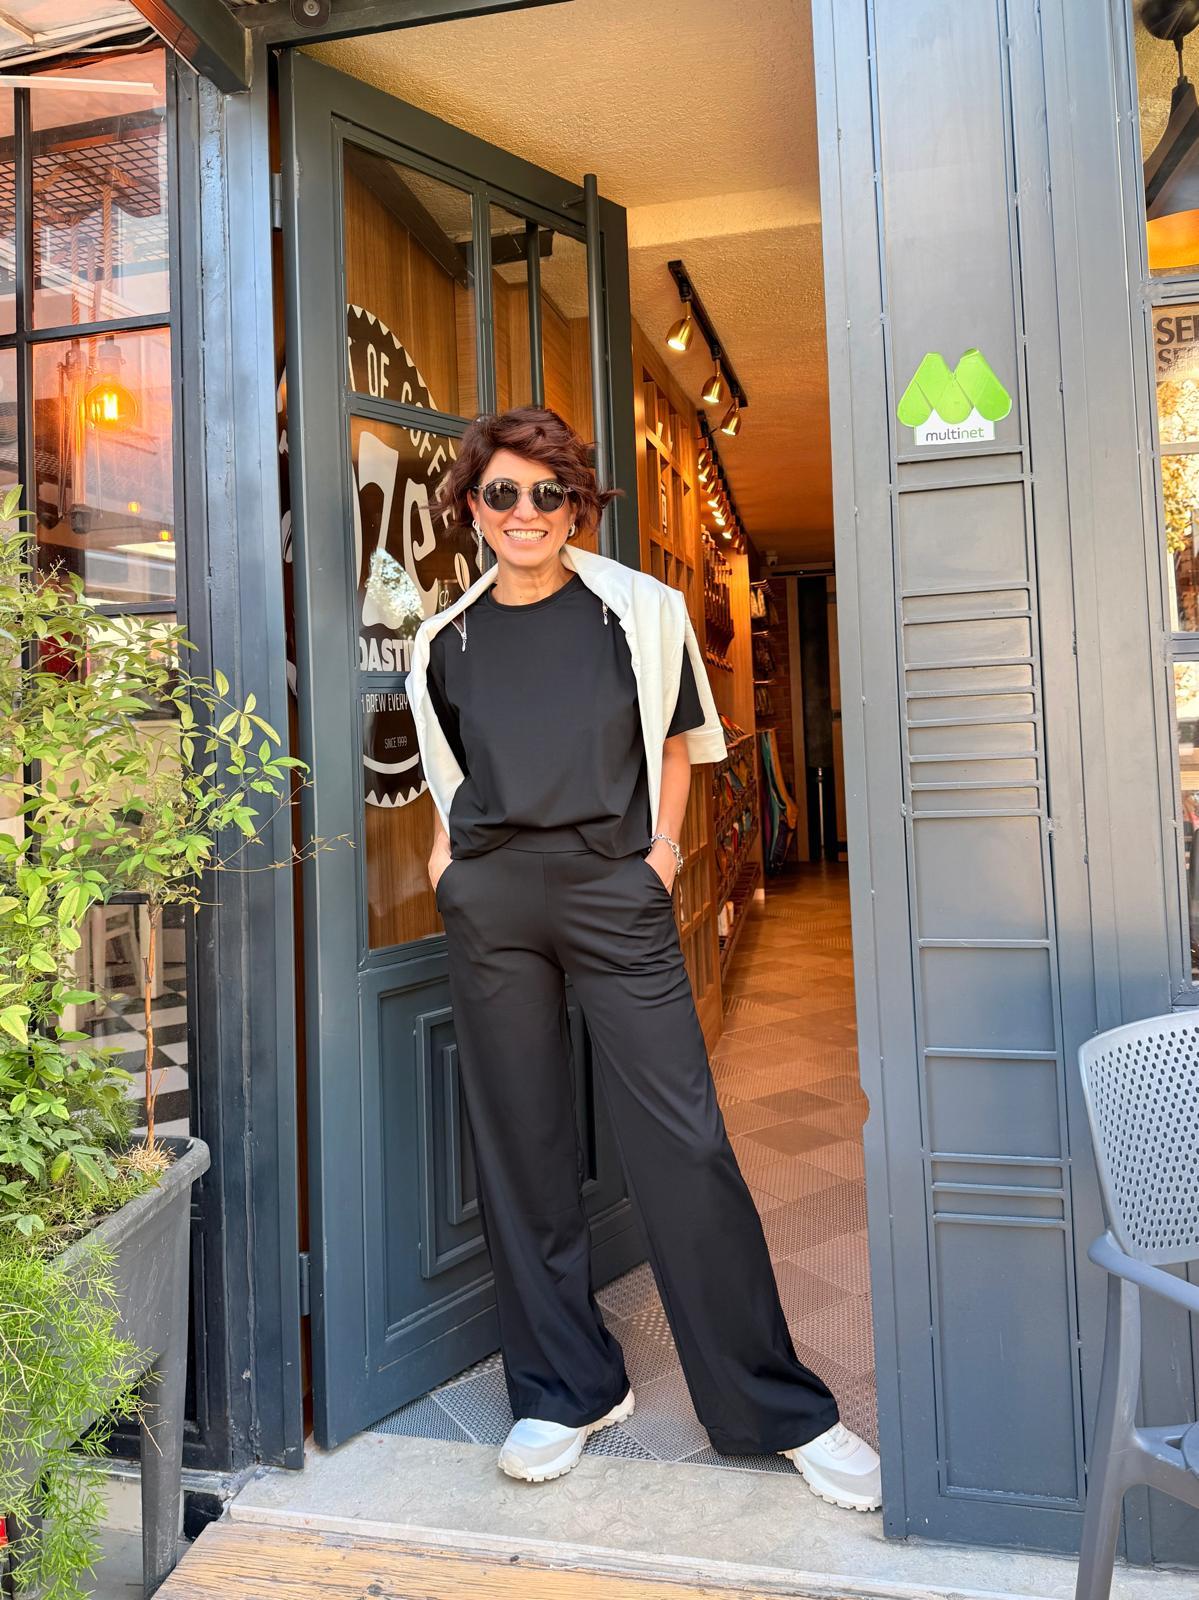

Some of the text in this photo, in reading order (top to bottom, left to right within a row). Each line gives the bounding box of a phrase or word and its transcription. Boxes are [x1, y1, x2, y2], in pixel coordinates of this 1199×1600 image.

[366, 343, 390, 398] OF
[925, 427, 985, 441] multinet
[366, 693, 386, 713] BREW
[388, 693, 408, 711] EVERY
[384, 737, 397, 749] SINCE
